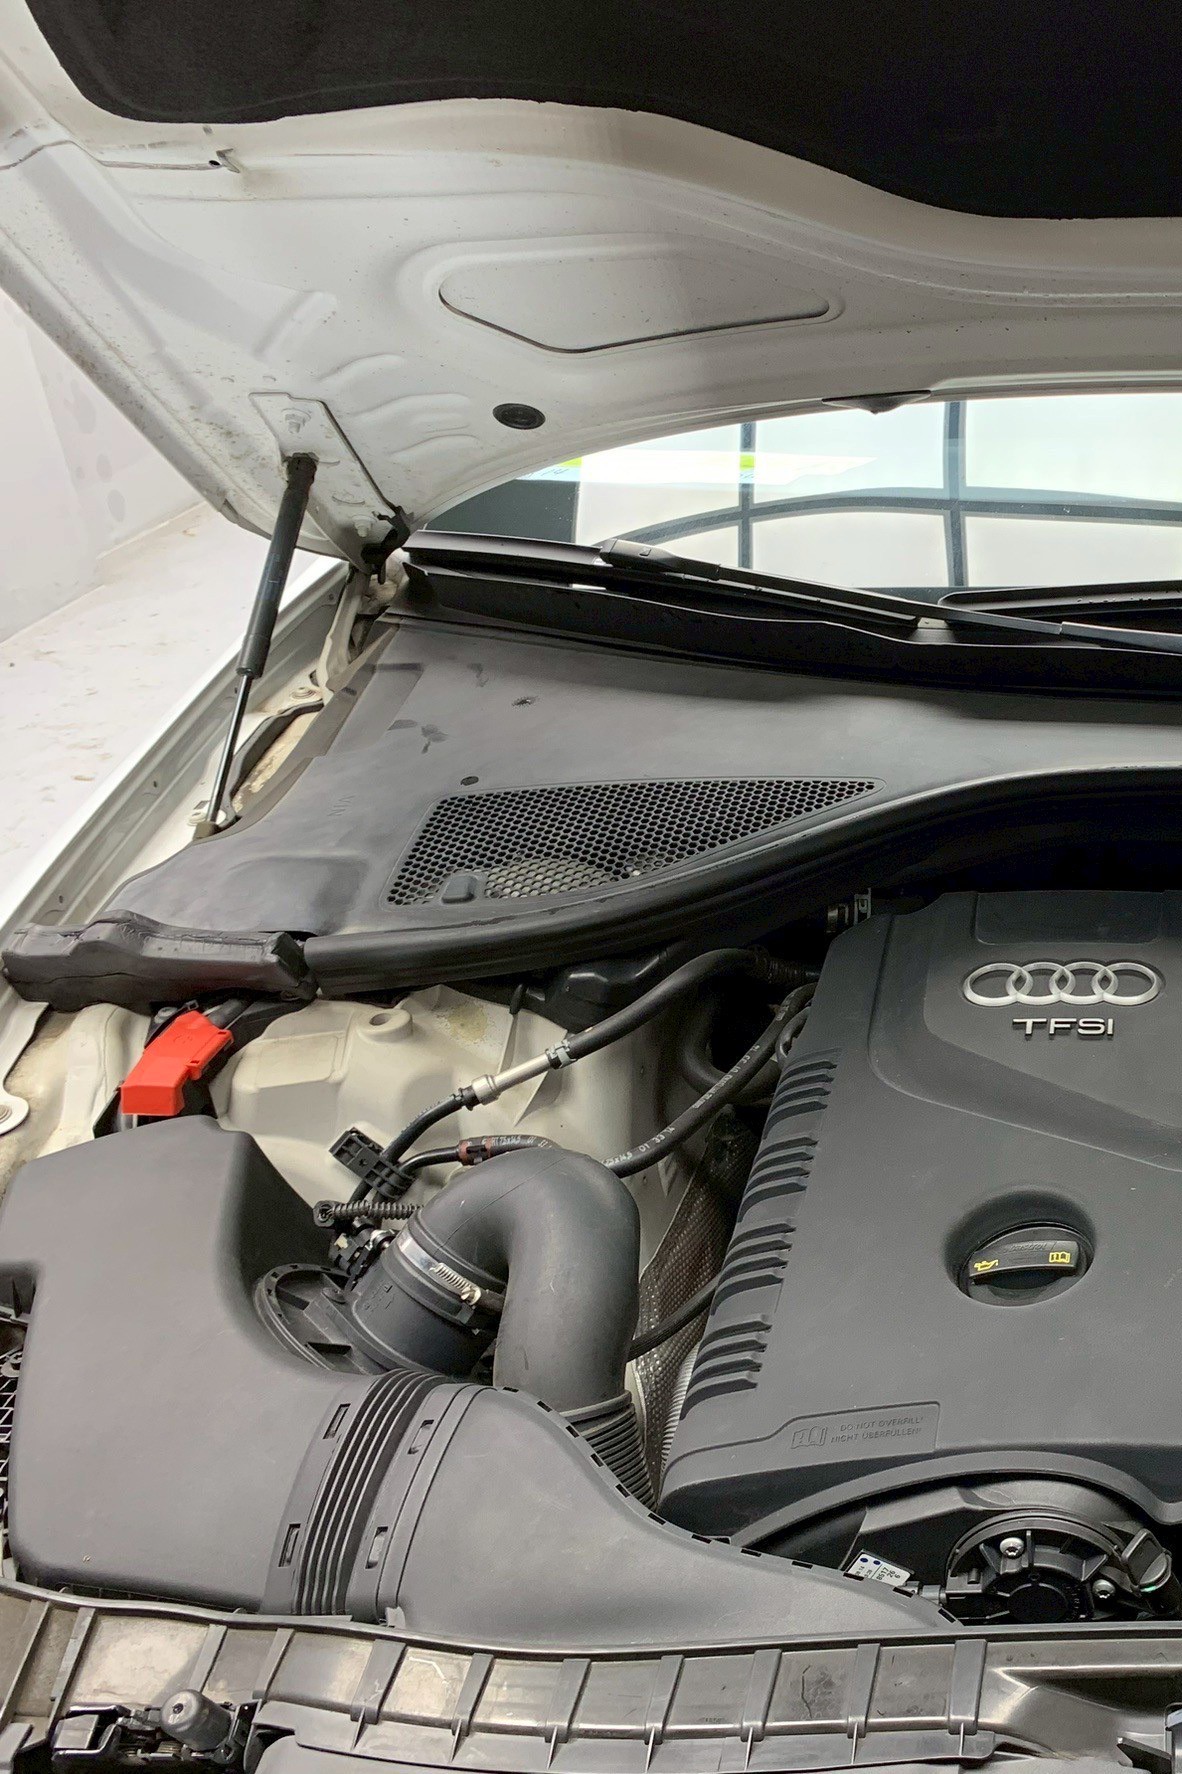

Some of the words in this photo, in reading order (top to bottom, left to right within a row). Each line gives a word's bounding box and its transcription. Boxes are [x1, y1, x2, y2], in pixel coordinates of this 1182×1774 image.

[1012, 1017, 1114, 1036] TFSI
[840, 1423, 854, 1432] DO
[856, 1420, 876, 1430] NOT
[830, 1433, 860, 1443] NICHT
